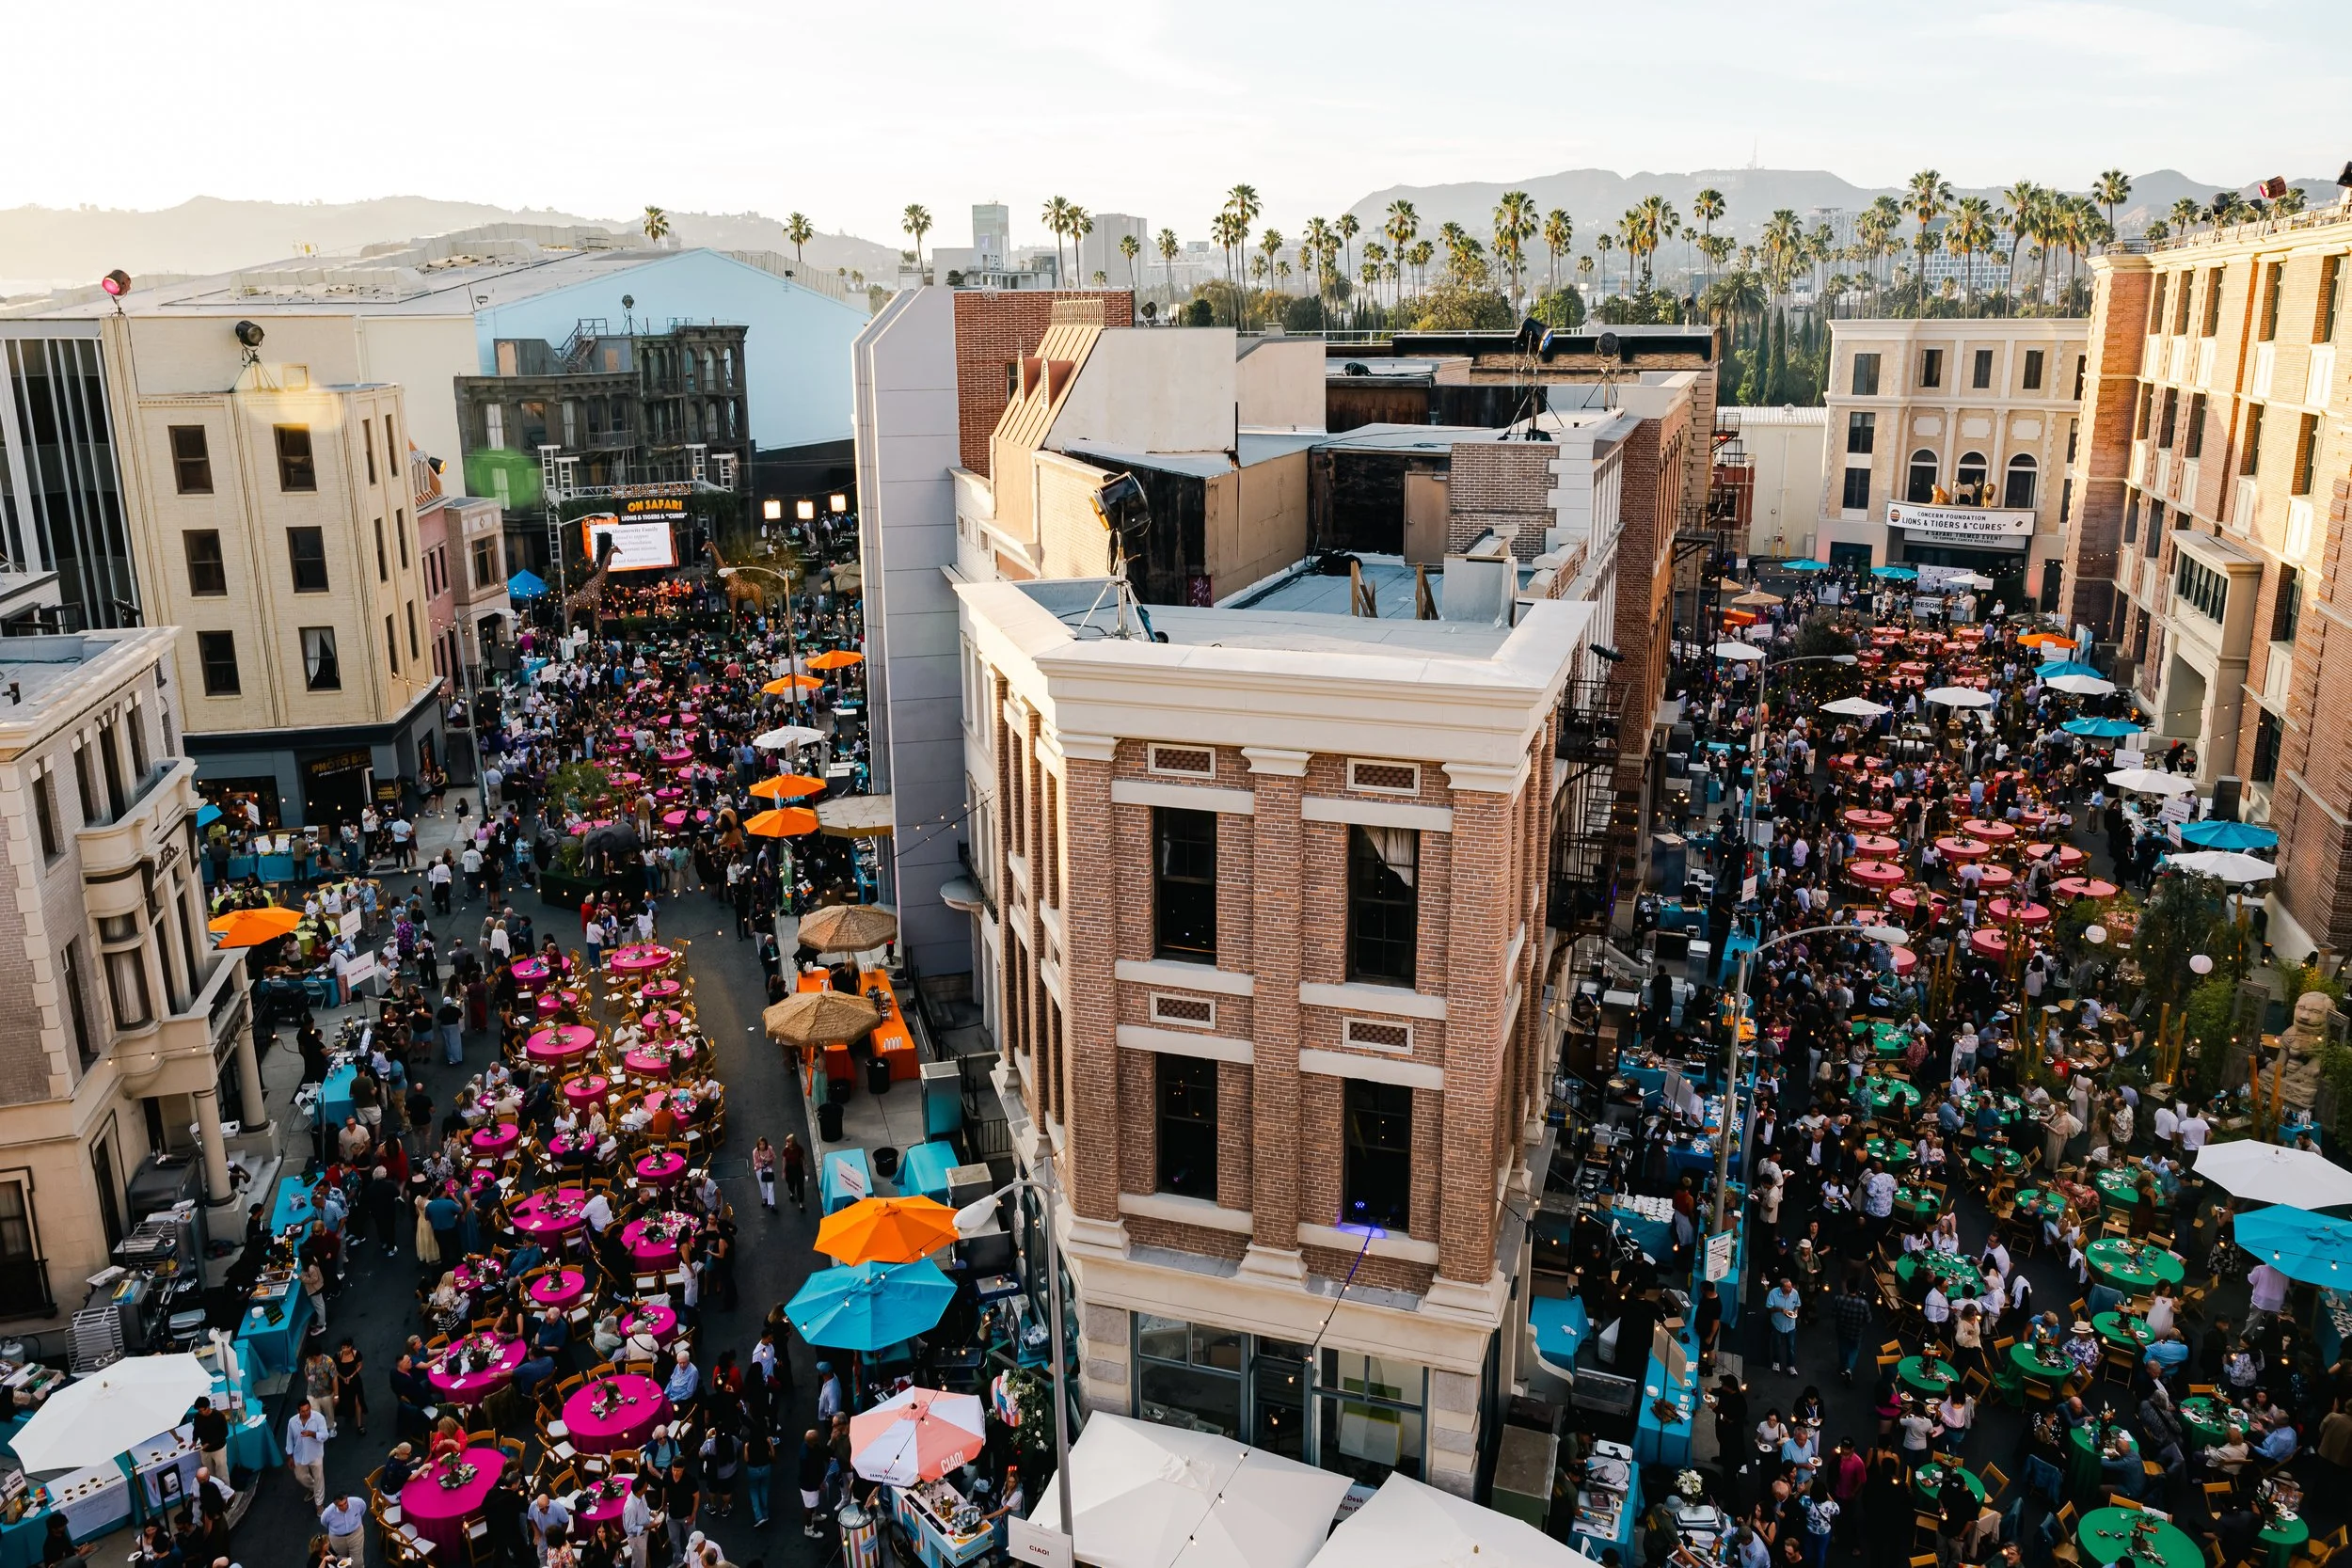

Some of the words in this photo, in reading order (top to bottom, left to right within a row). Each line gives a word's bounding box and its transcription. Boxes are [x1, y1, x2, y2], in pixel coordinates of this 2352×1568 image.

[612, 483, 691, 498] CONCERN
[628, 501, 644, 512] ON
[645, 499, 682, 510] SAFARI
[1901, 517, 1921, 526] LIONS
[1931, 520, 1960, 529] TIGERS
[312, 757, 349, 773] PHOTO
[940, 1450, 965, 1474] CIAO!
[1347, 1496, 1363, 1504] Desk
[1029, 1544, 1050, 1556] CIAO!
